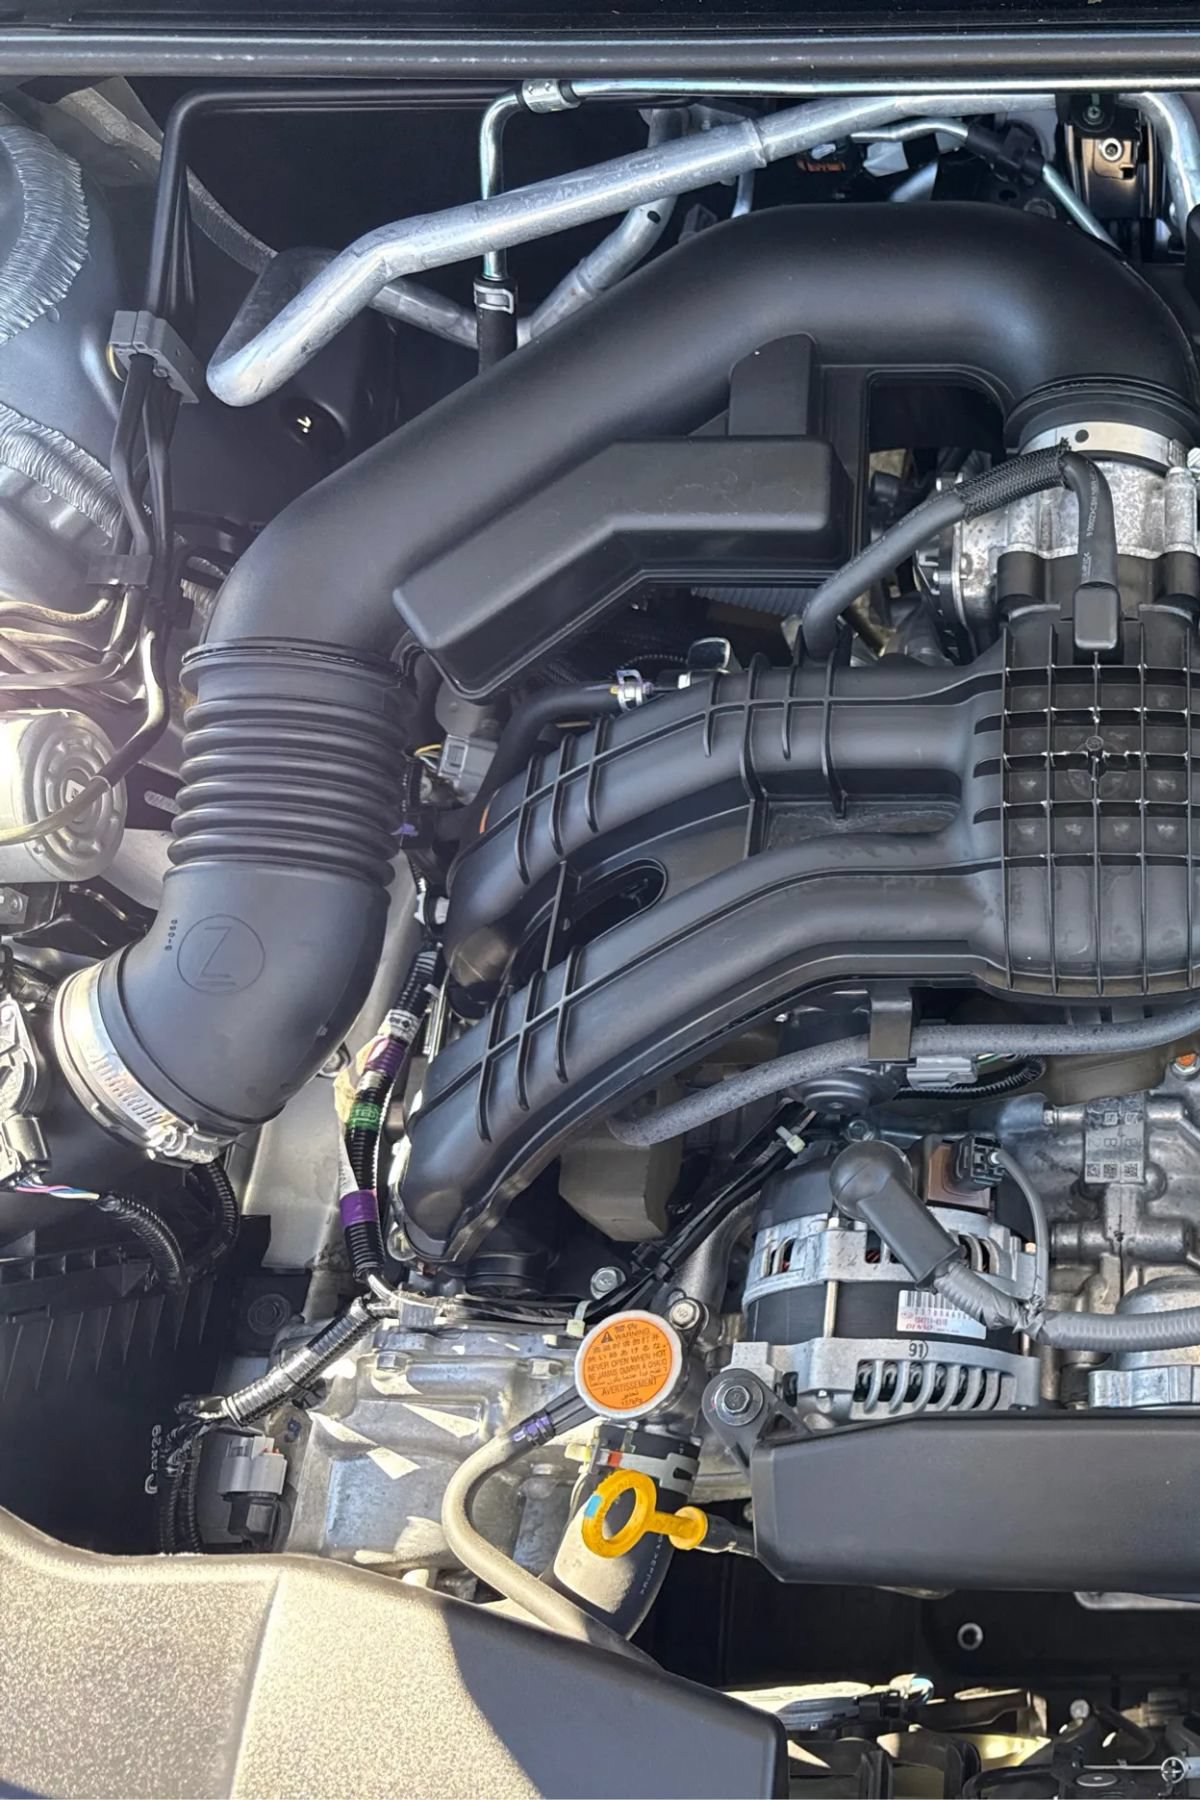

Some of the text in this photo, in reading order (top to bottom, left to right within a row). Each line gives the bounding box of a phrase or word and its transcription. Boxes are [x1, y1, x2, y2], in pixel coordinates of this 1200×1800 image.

[614, 1328, 650, 1340] WARNING
[588, 1361, 609, 1372] NEVER
[611, 1357, 629, 1368] OPEN
[630, 1353, 650, 1364] WHEN
[598, 1369, 617, 1380] JAMAIS
[620, 1364, 640, 1375] OUVRIR
[648, 1358, 667, 1369] CHAUD
[601, 1375, 656, 1396] AVERTISSEMENT
